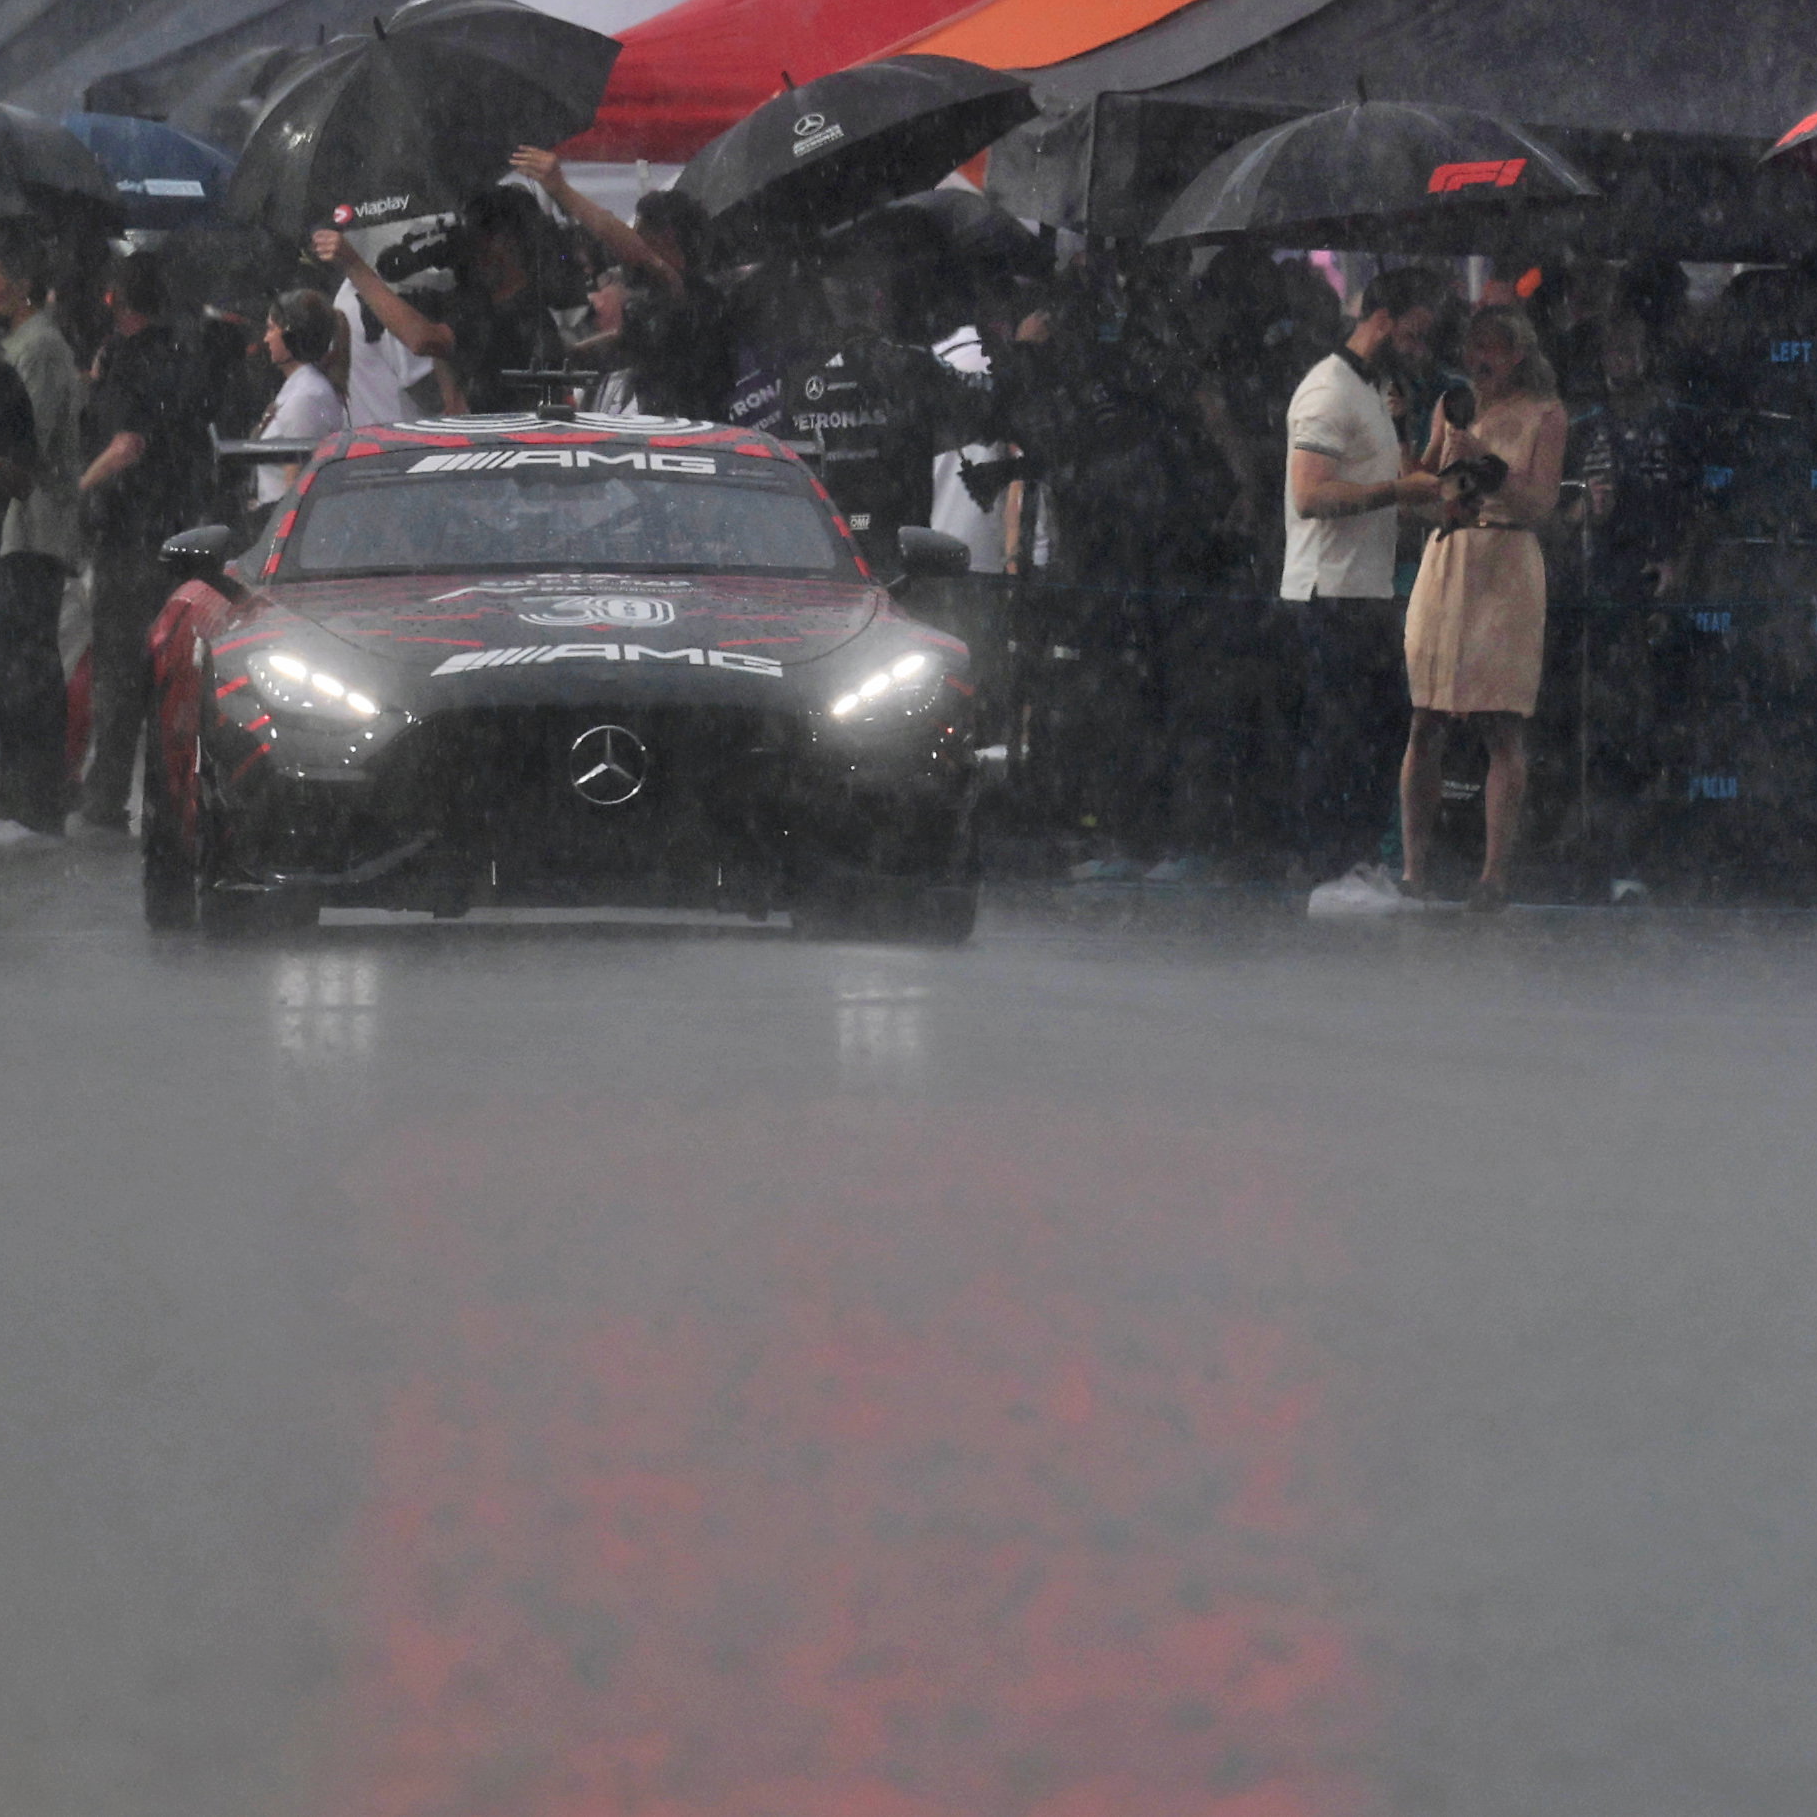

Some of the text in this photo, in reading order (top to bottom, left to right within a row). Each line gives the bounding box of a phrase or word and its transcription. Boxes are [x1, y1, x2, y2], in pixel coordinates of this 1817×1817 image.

[355, 193, 410, 222] viaplay
[503, 450, 715, 475] AMG
[538, 643, 784, 679] AMG
